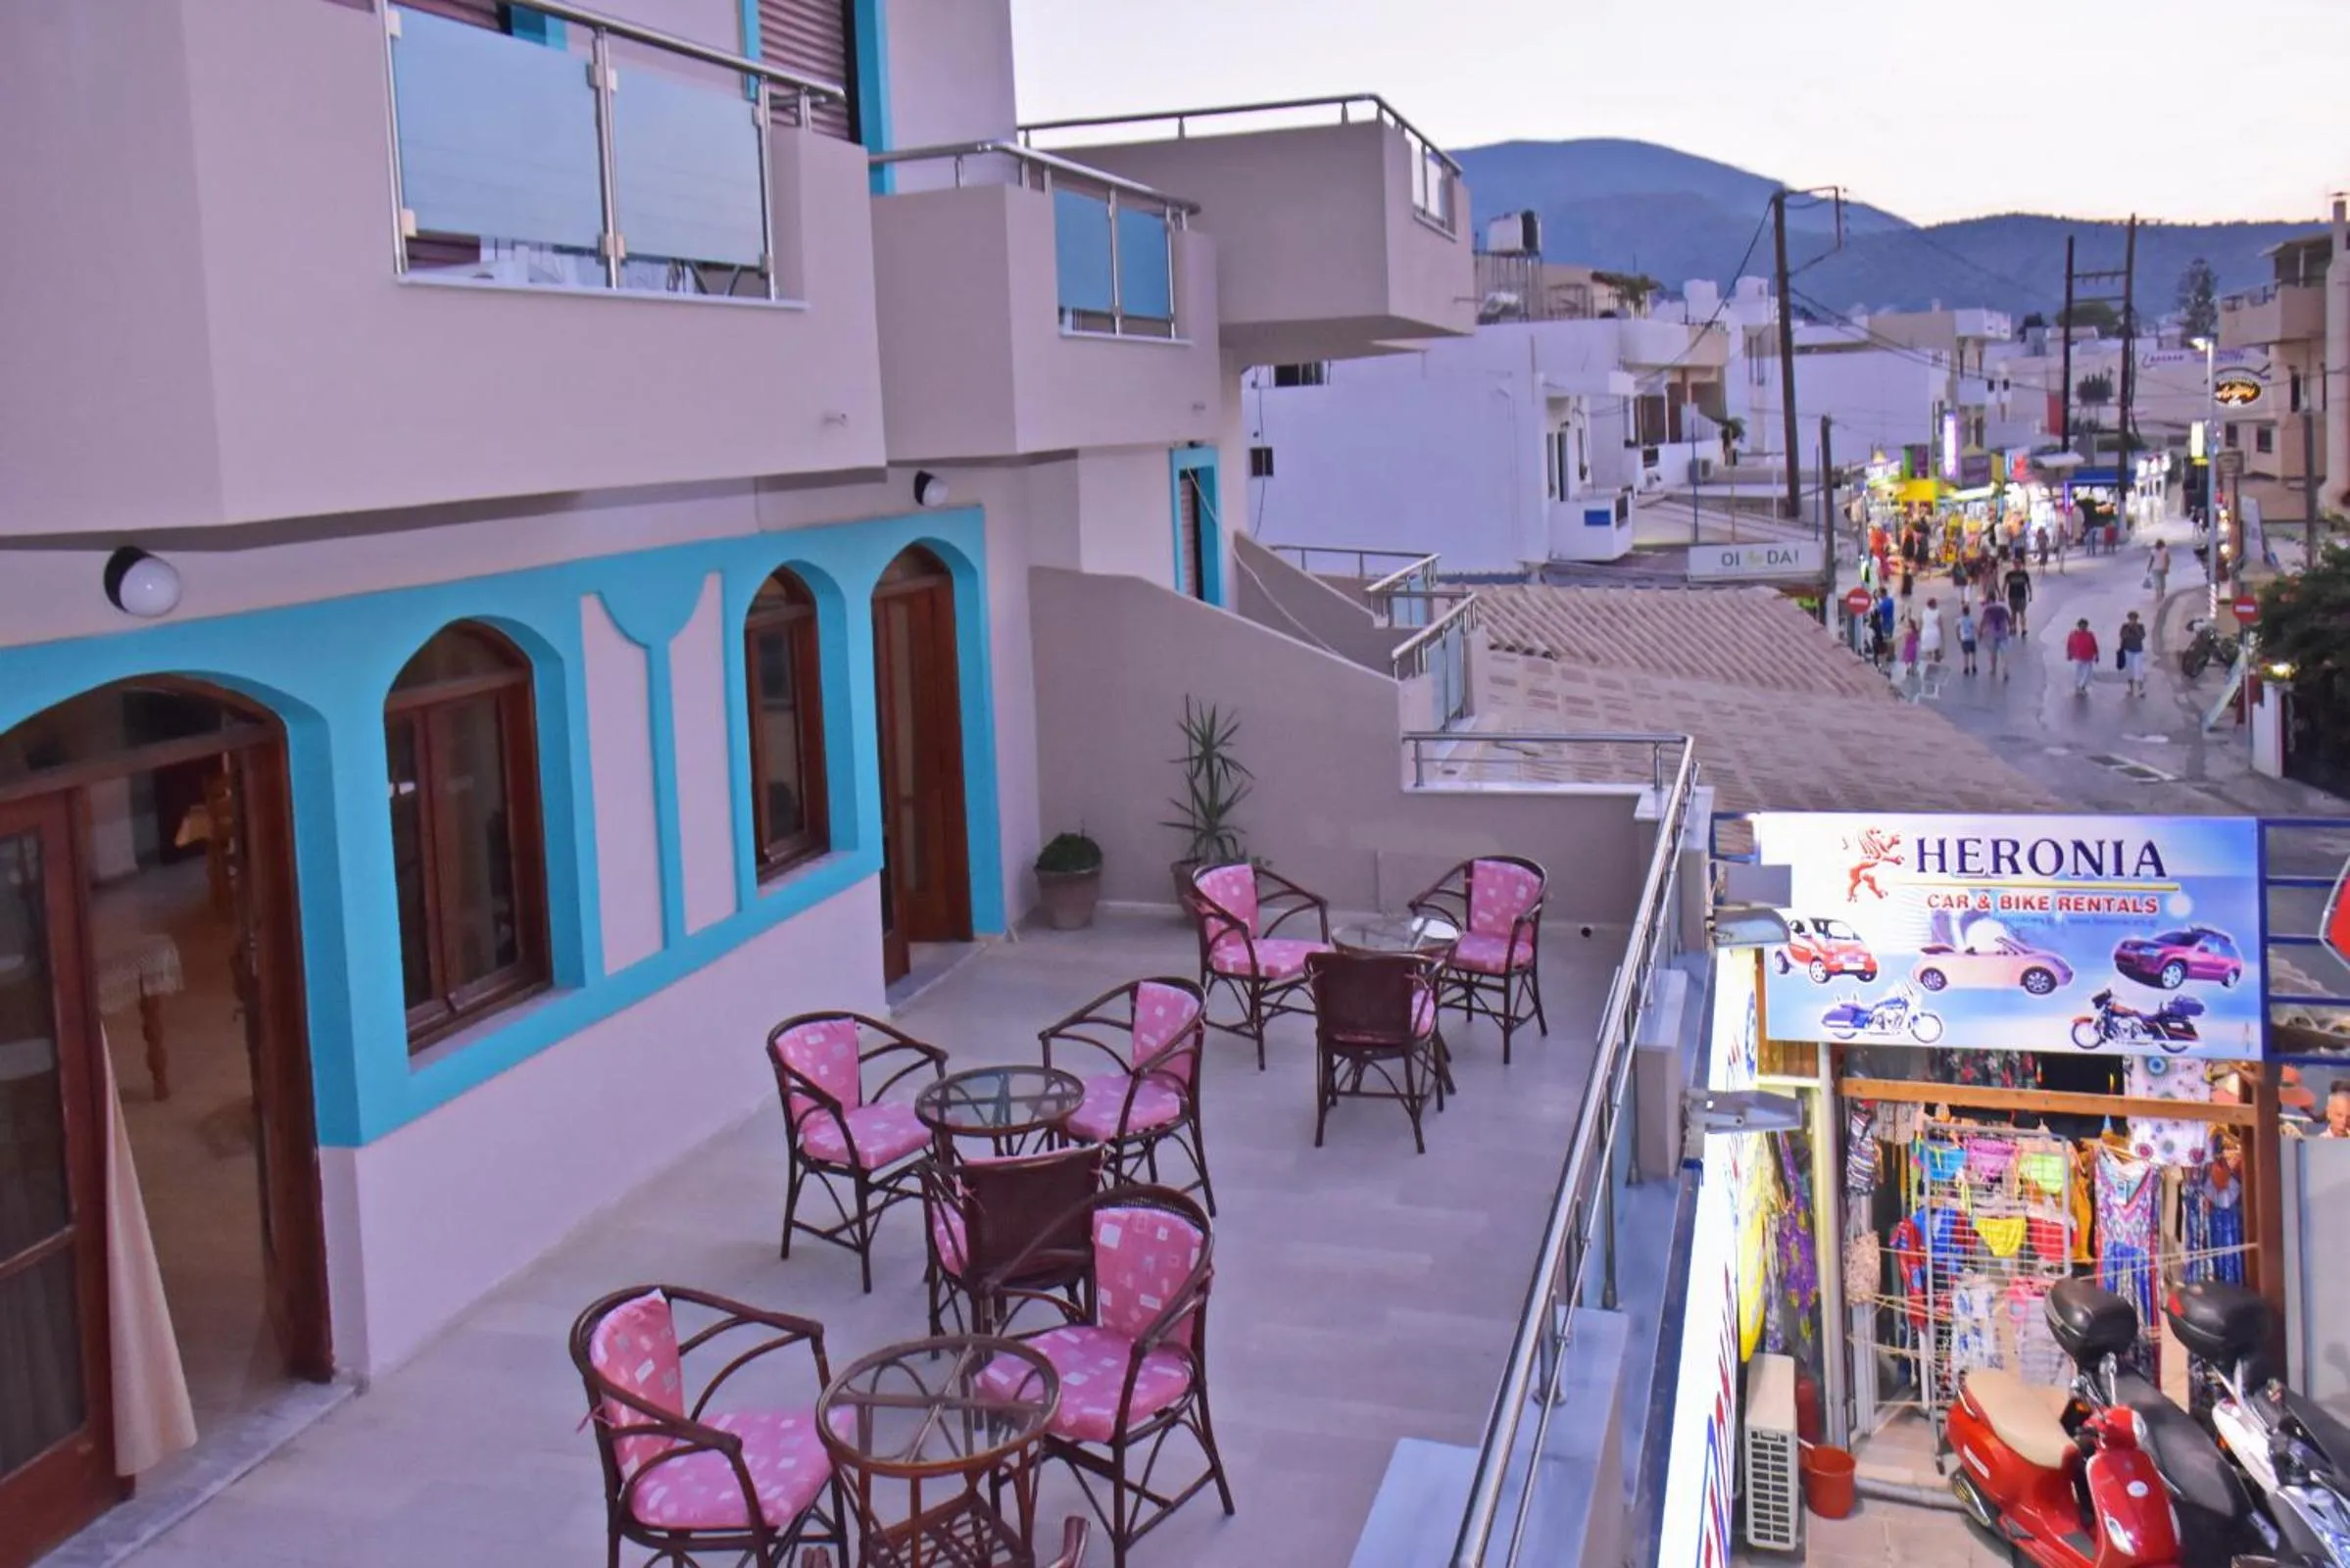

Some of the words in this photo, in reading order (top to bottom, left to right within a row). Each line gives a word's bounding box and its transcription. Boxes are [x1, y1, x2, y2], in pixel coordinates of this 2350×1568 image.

[1916, 837, 2168, 878] HERONIA
[1927, 893, 1969, 909] CAR
[1977, 894, 1991, 910] &
[1999, 894, 2050, 911] BIKE
[2057, 895, 2159, 914] RENTALS
